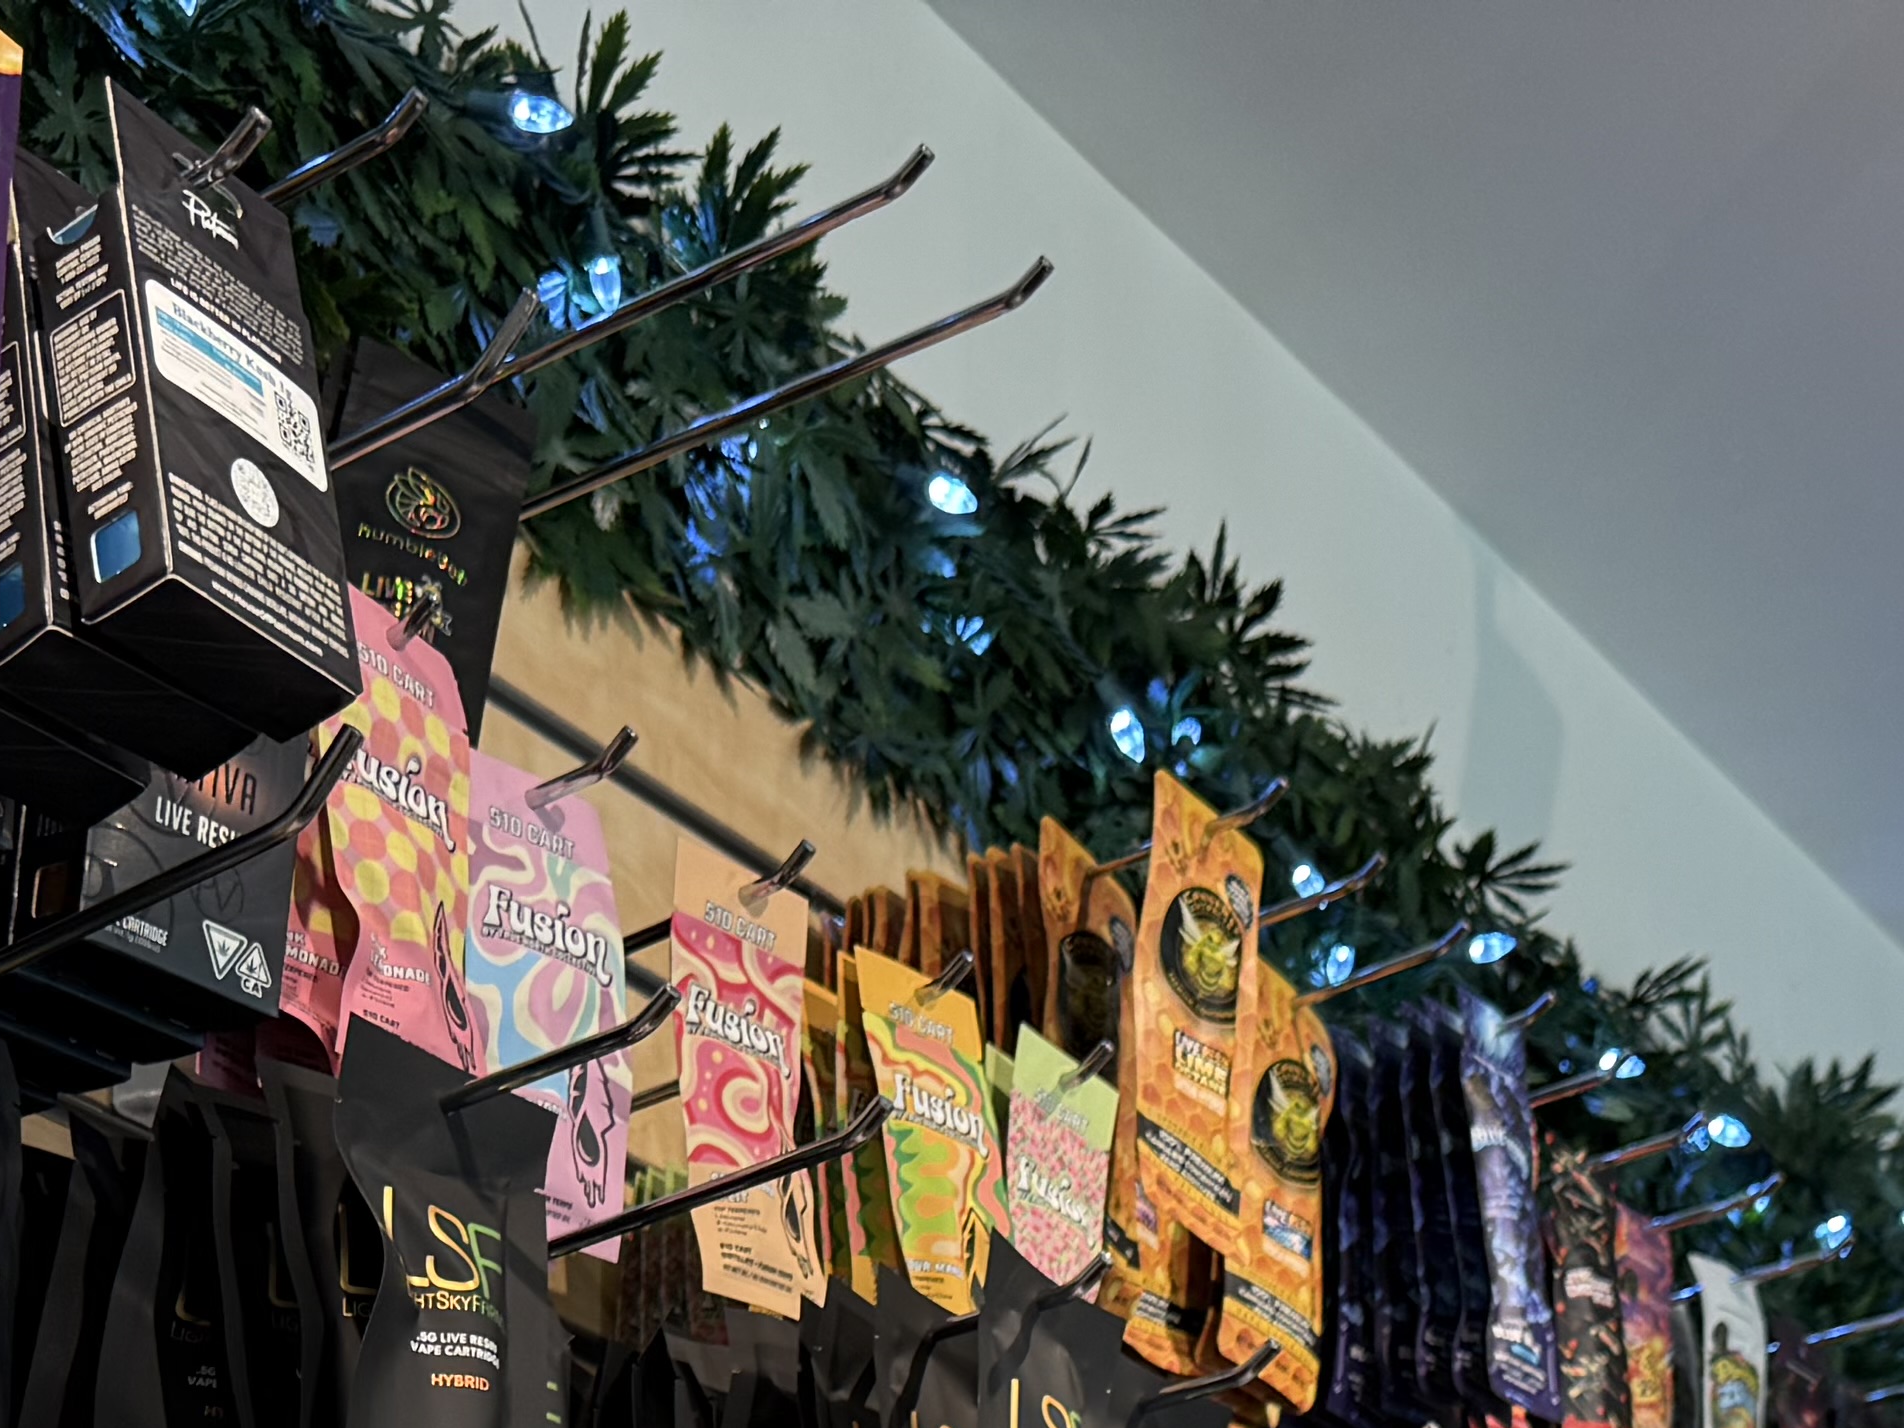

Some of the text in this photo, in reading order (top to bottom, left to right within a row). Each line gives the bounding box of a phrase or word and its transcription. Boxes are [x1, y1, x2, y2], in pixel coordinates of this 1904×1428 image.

[173, 302, 277, 387] Blackberry Kush
[357, 641, 435, 707] 510 CART
[488, 806, 575, 860] 510 CART
[483, 884, 612, 988] Fusion
[685, 980, 791, 1079] Fusion
[892, 1071, 987, 1159] Fusion
[431, 1373, 490, 1392] HYBRID
